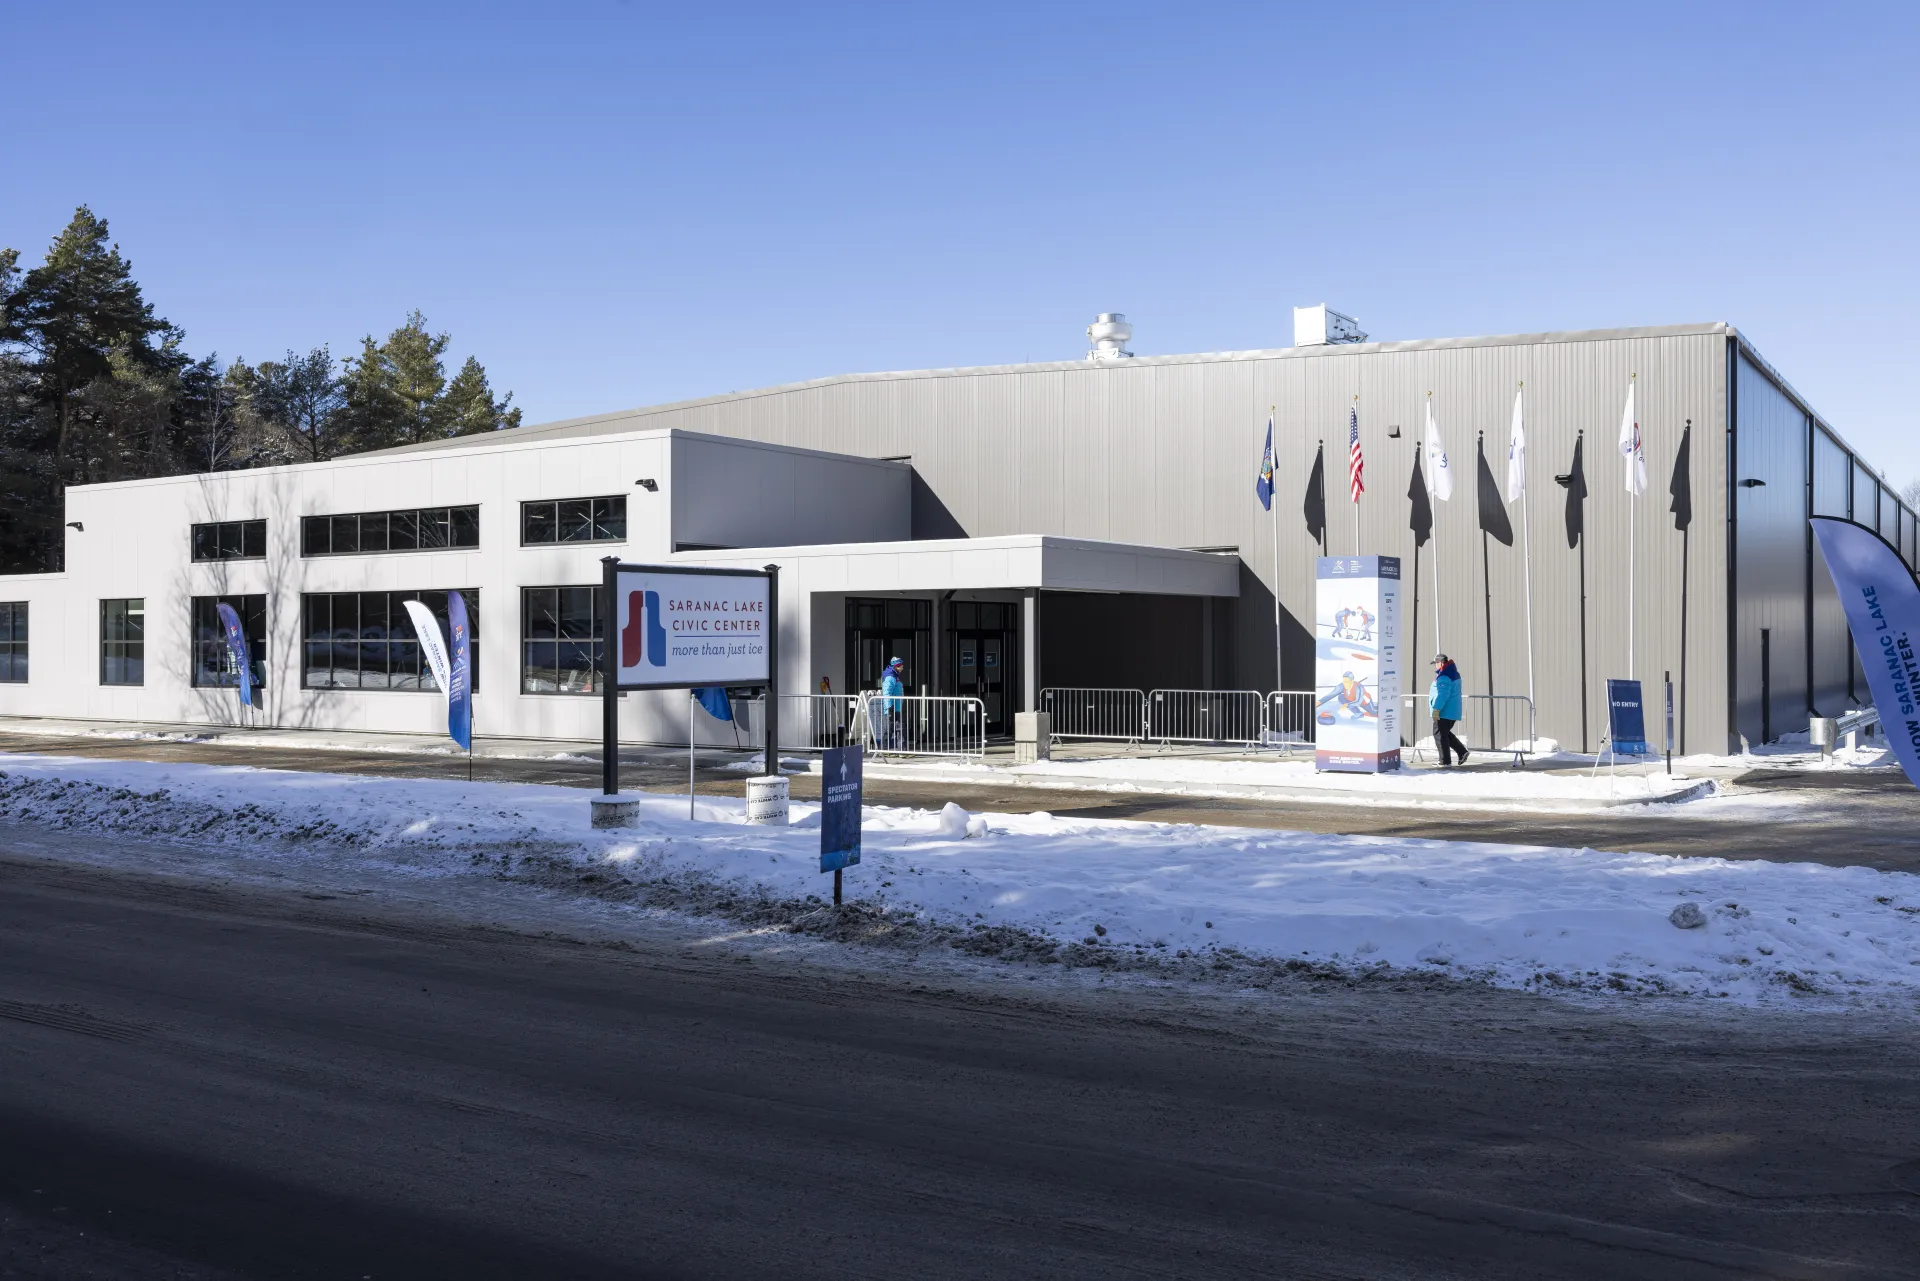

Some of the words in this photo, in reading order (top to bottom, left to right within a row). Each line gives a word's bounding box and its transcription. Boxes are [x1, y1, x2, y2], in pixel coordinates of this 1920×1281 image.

[669, 600, 729, 612] SARANAC
[734, 601, 763, 612] LAKE
[1862, 586, 1887, 631] LAKE
[672, 620, 708, 631] CIVIC
[714, 620, 760, 631] CENTER
[672, 646, 699, 656] more
[701, 643, 725, 656] than
[727, 643, 746, 658] just
[748, 643, 763, 655] ice
[1880, 635, 1914, 715] SARANAC
[1906, 720, 1920, 760] OW
[827, 782, 857, 795] SPECTATOR
[827, 792, 852, 804] PARKING
